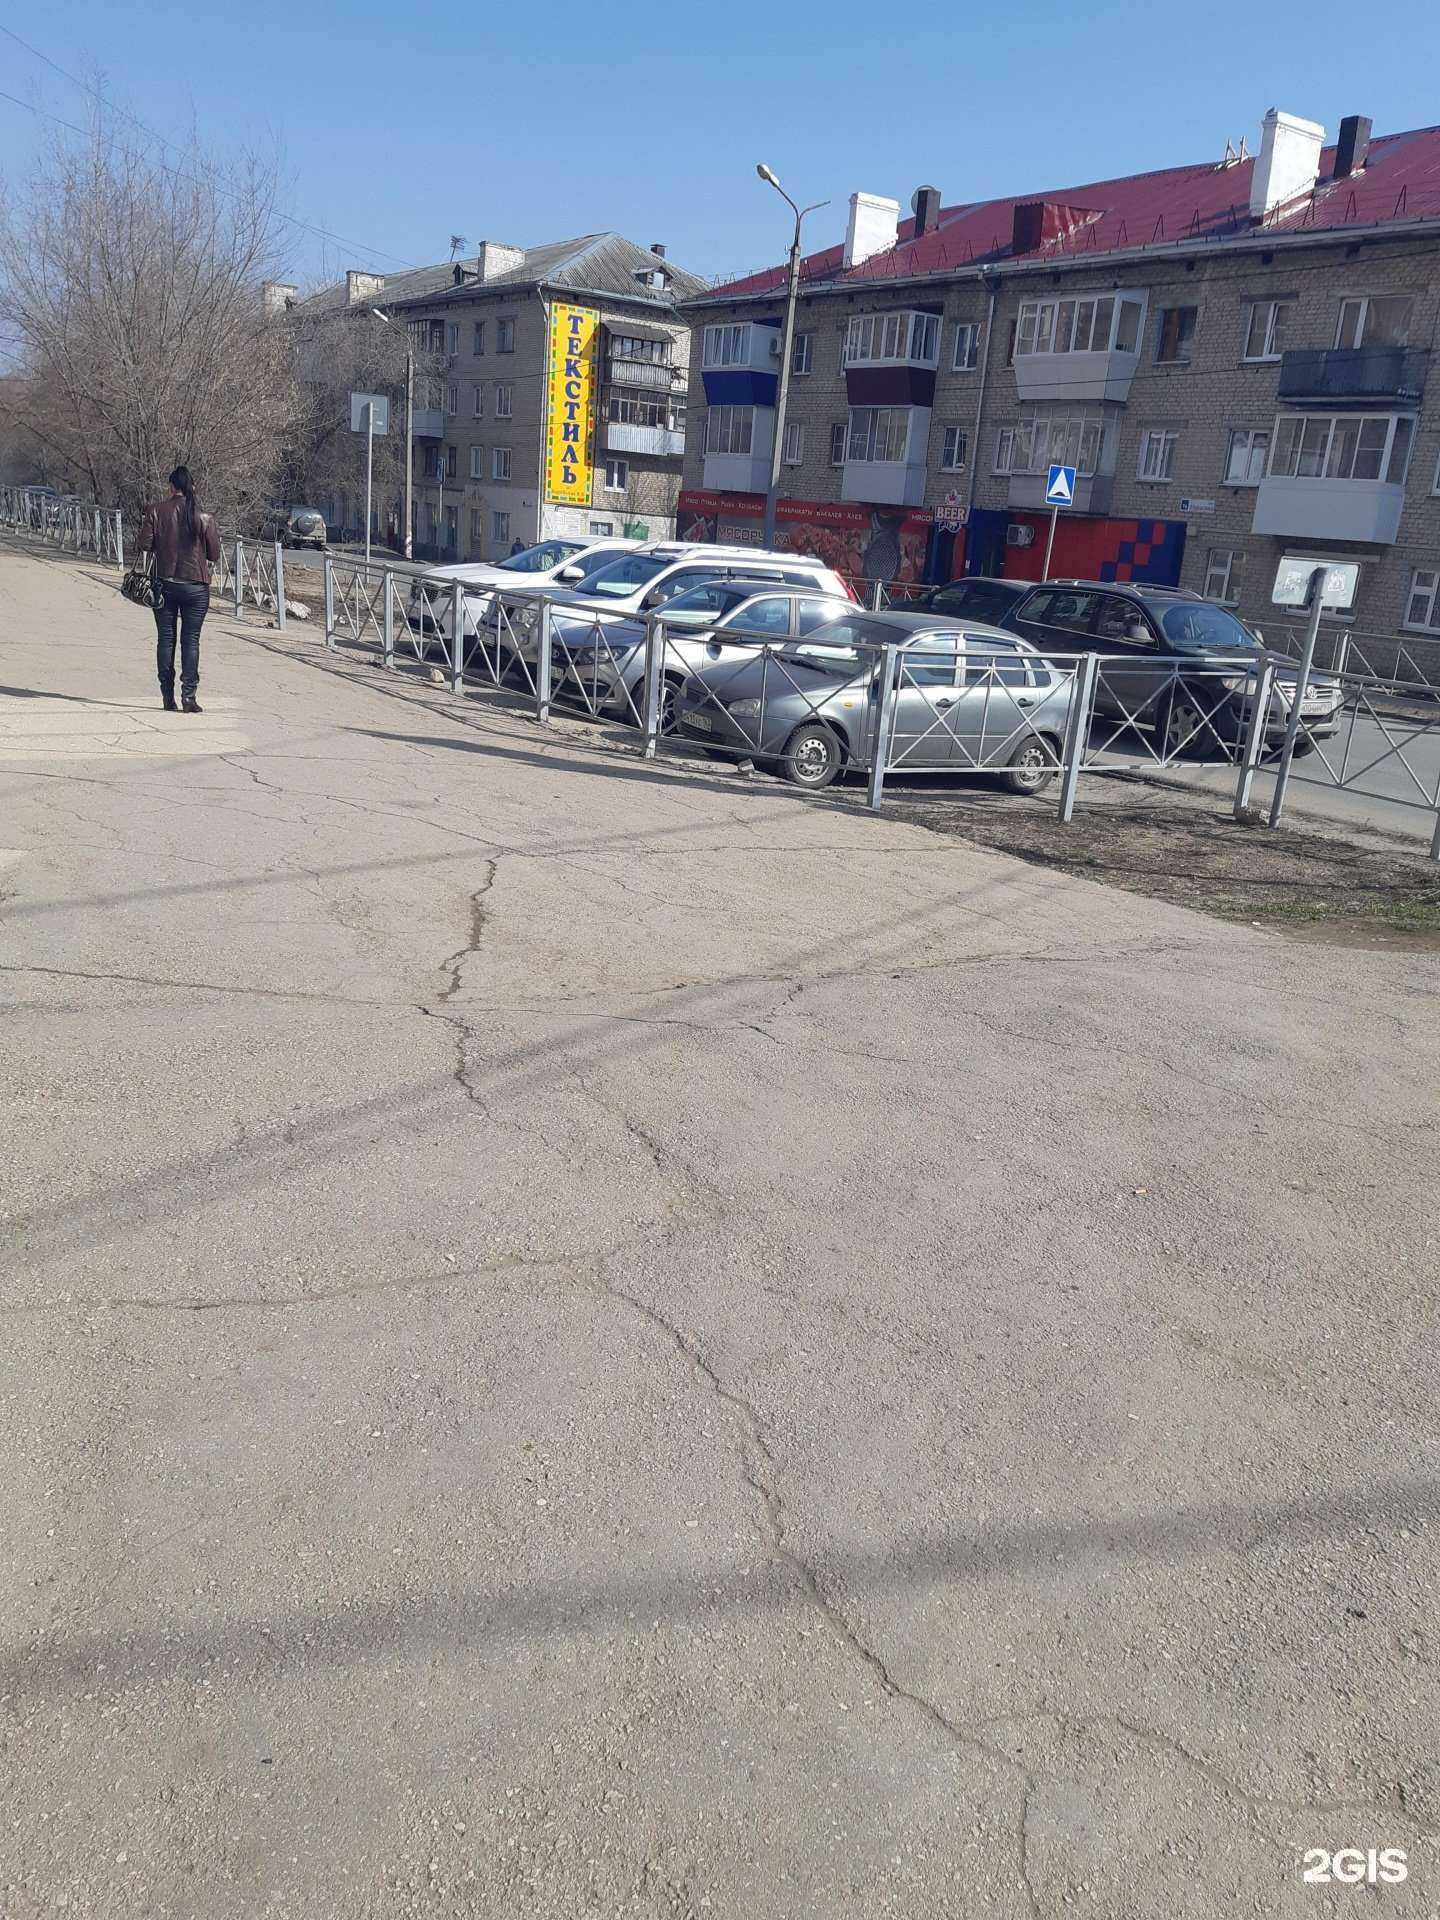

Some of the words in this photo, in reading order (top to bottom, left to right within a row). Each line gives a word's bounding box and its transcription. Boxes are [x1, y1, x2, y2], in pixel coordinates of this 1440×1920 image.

[562, 315, 584, 485] ТЕКСТИЛЬ
[936, 506, 966, 521] BEER
[719, 525, 792, 546] МЯСОРУКА
